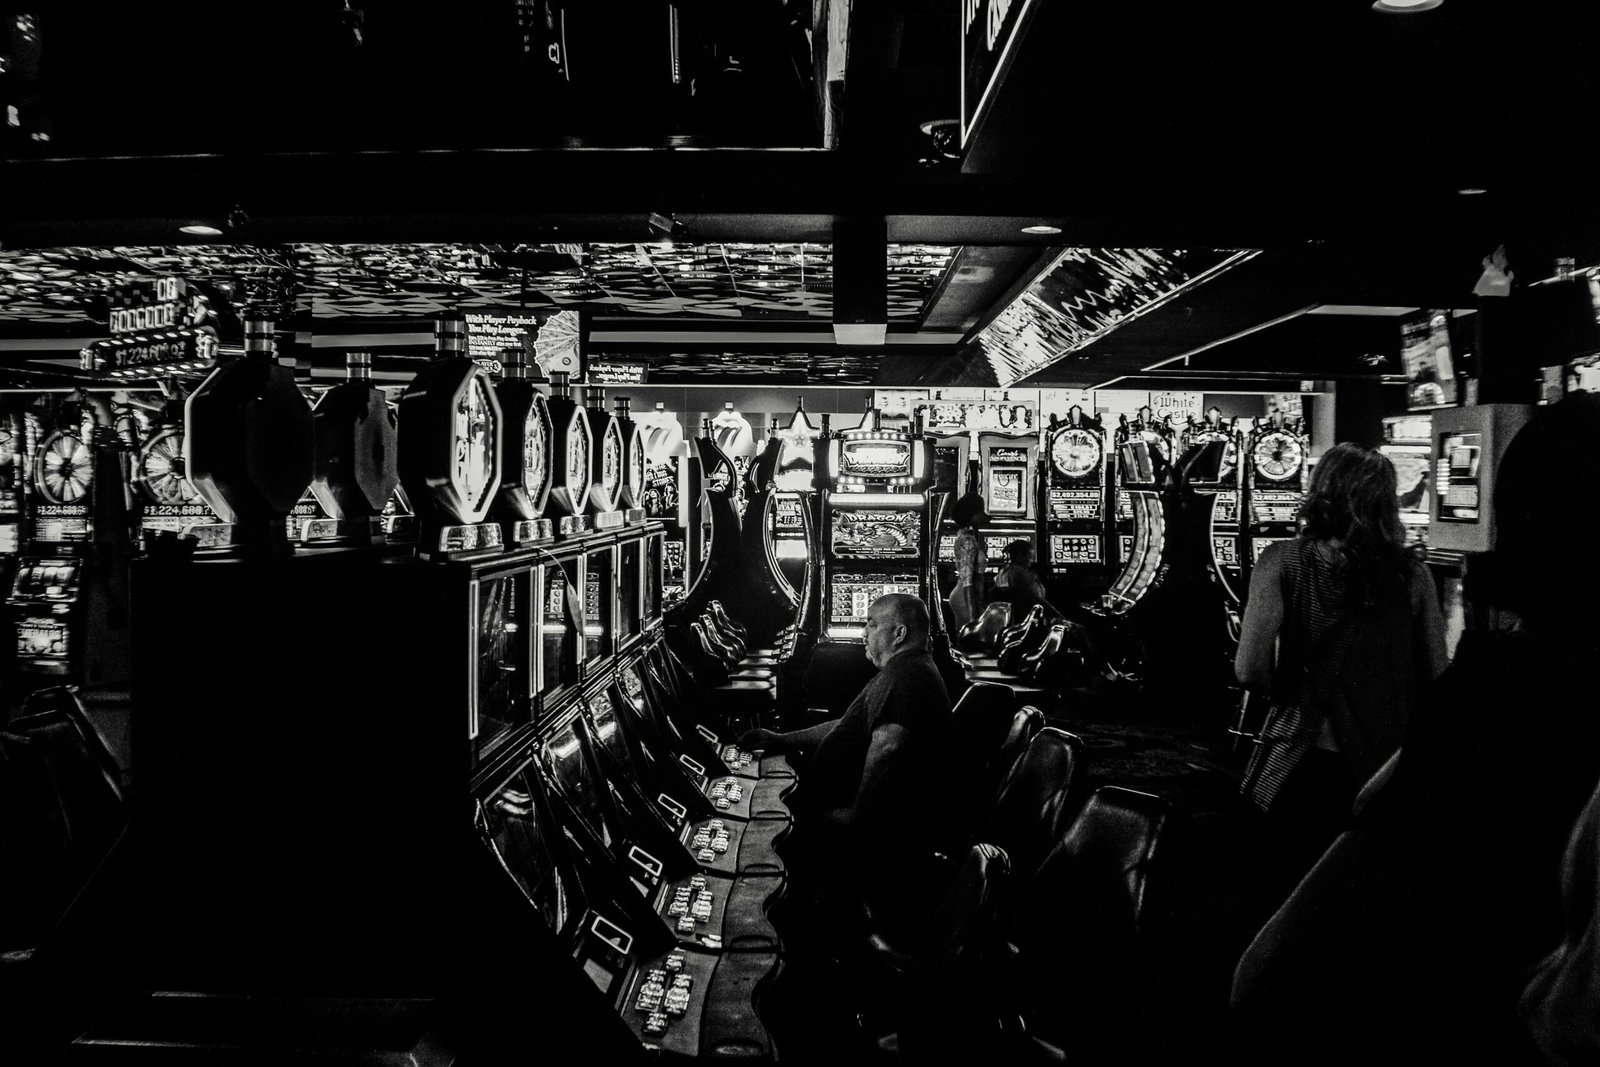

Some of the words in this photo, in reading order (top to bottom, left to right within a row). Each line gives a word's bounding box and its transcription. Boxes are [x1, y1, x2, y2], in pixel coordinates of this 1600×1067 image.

[465, 314, 483, 324] With
[484, 315, 507, 326] Player
[507, 315, 537, 327] Payback
[468, 324, 481, 333] You
[482, 324, 498, 336] Play
[1160, 396, 1195, 409] White
[844, 513, 909, 523] DRAGON
